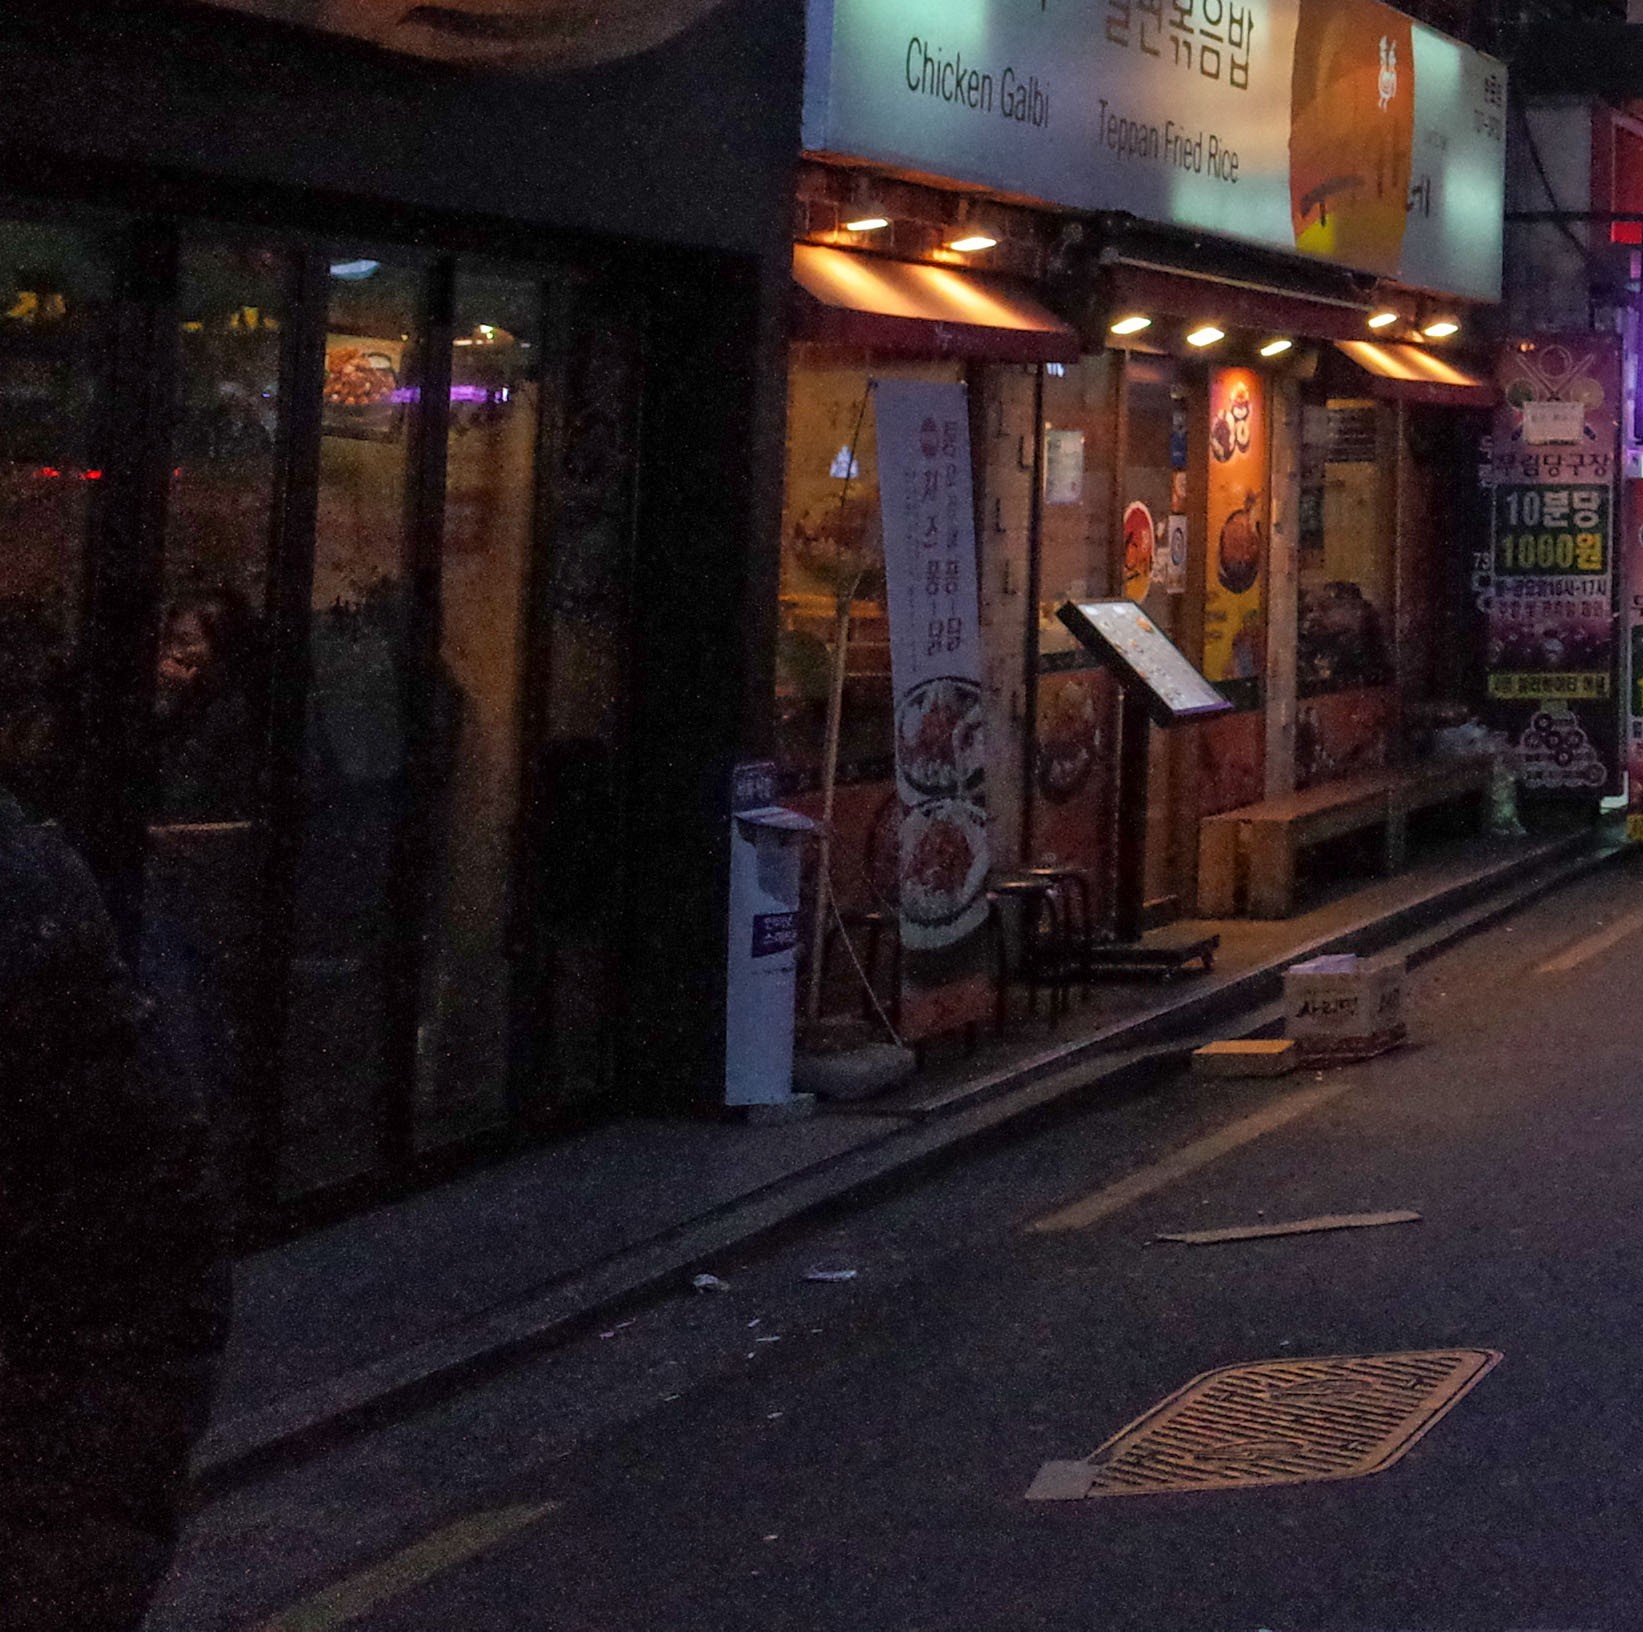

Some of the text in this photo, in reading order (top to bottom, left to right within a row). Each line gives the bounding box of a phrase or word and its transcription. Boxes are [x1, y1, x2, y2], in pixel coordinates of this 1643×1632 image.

[904, 34, 1051, 131] Chicken Galbi
[1097, 98, 1241, 186] Teppan Fried Rice
[1505, 490, 1601, 529] 10분당
[1502, 533, 1603, 571] 1000원
